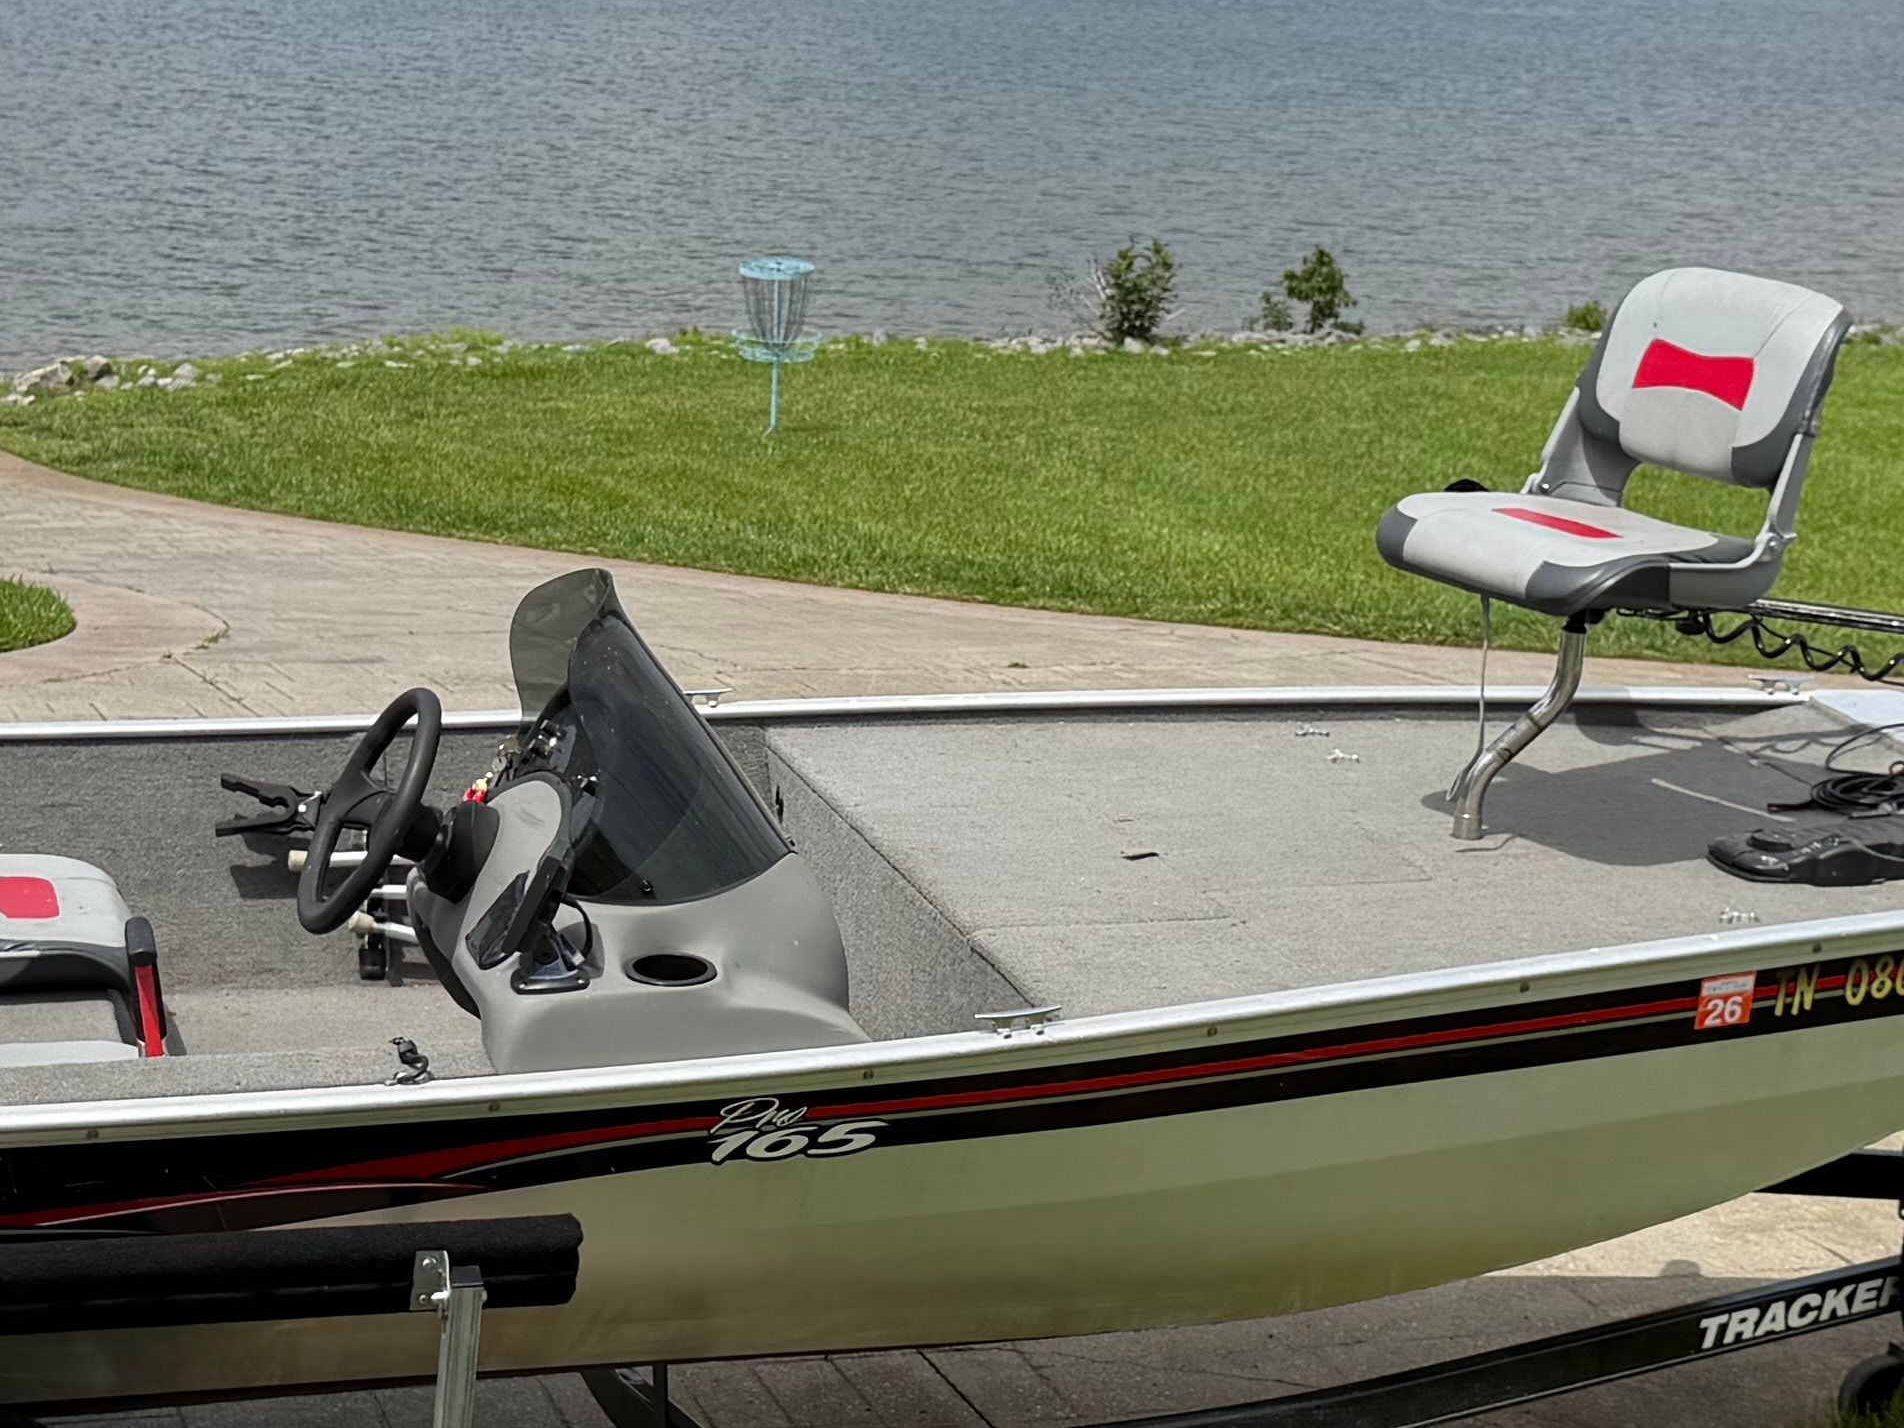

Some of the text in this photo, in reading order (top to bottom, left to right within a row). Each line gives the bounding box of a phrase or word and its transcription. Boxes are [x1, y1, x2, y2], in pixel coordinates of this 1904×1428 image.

[1703, 995, 1744, 1028] 26
[709, 1097, 808, 1135] Pro
[706, 1120, 890, 1163] 165
